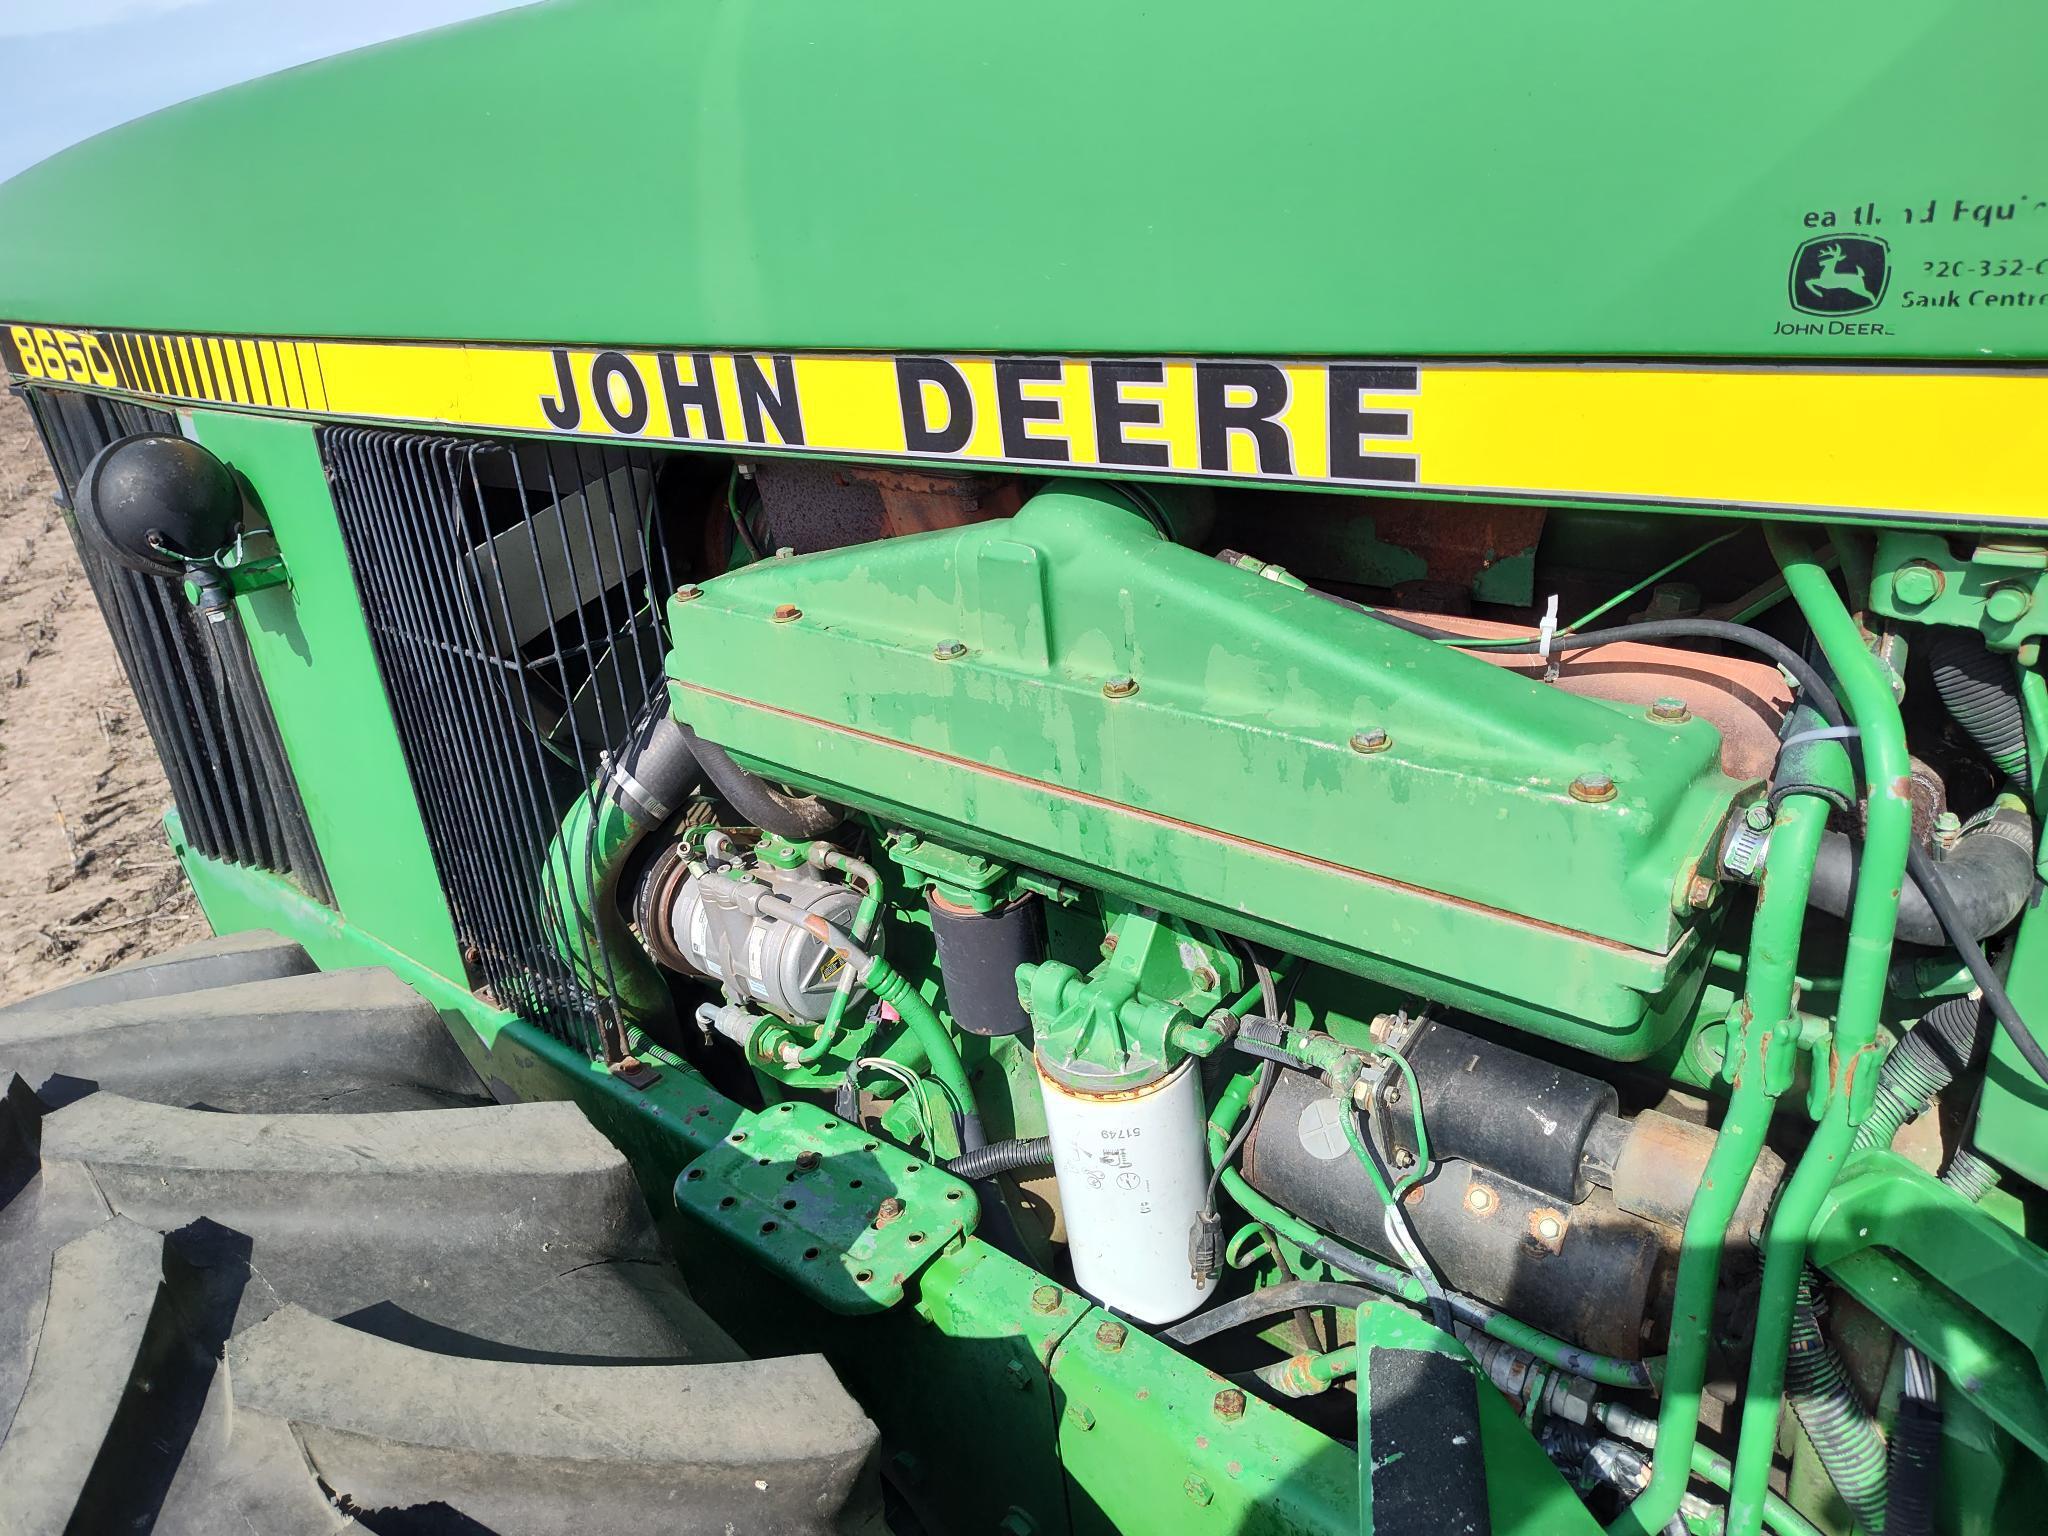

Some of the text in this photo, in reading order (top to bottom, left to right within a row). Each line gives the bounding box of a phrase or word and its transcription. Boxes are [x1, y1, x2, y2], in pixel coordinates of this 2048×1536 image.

[1901, 289, 1961, 309] Sauk
[1773, 320, 1896, 336] JOHN DEER
[10, 326, 118, 388] 8650
[540, 349, 1418, 483] JOHN DEERE
[1101, 1127, 1142, 1140] 51749
